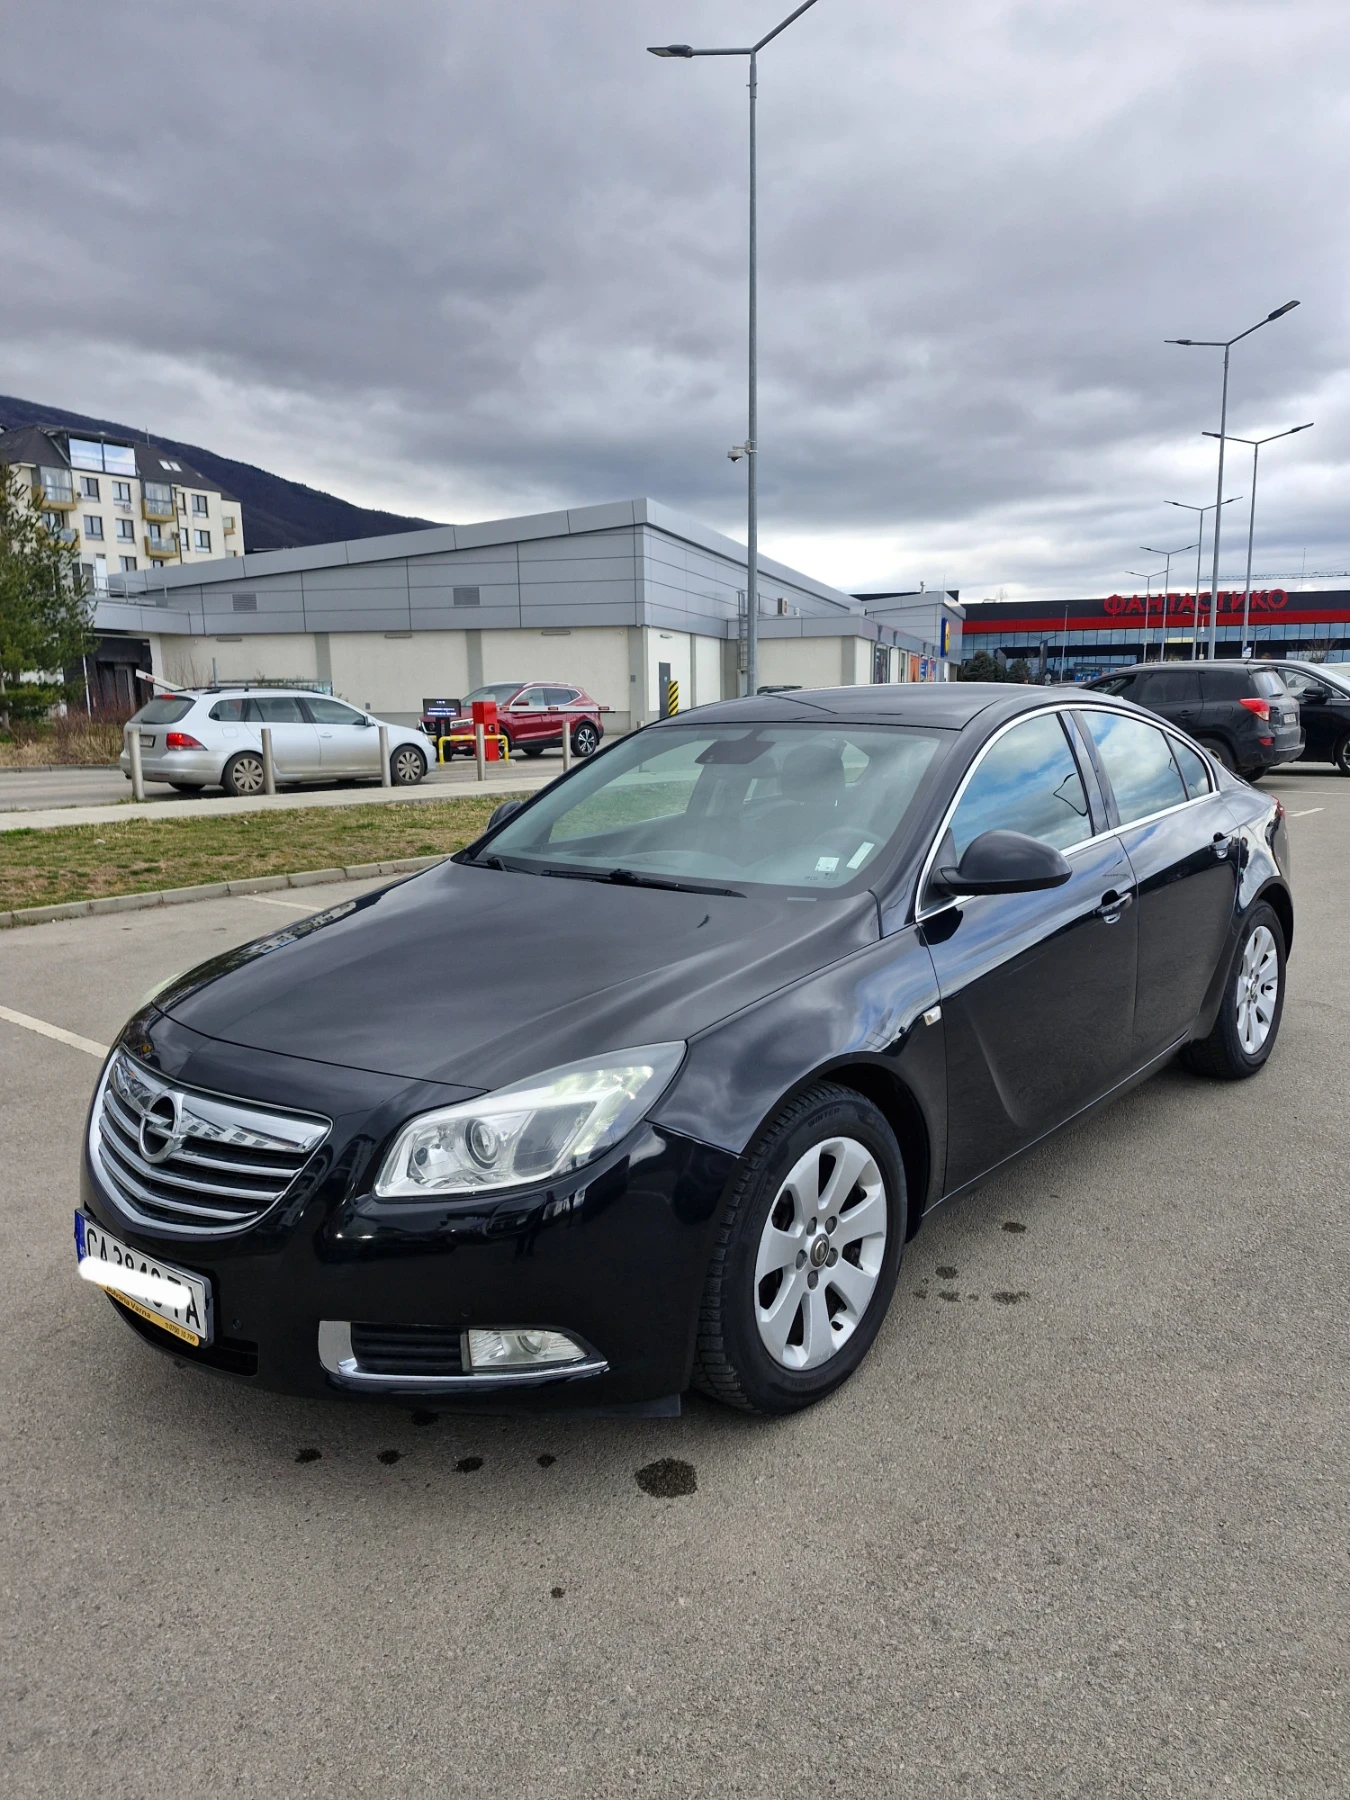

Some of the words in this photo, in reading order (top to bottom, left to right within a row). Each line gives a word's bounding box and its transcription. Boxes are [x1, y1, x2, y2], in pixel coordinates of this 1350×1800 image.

[1103, 588, 1289, 615] ФАНТАСТИКО
[807, 1107, 840, 1128] WINTER
[131, 1301, 151, 1319] Varna
